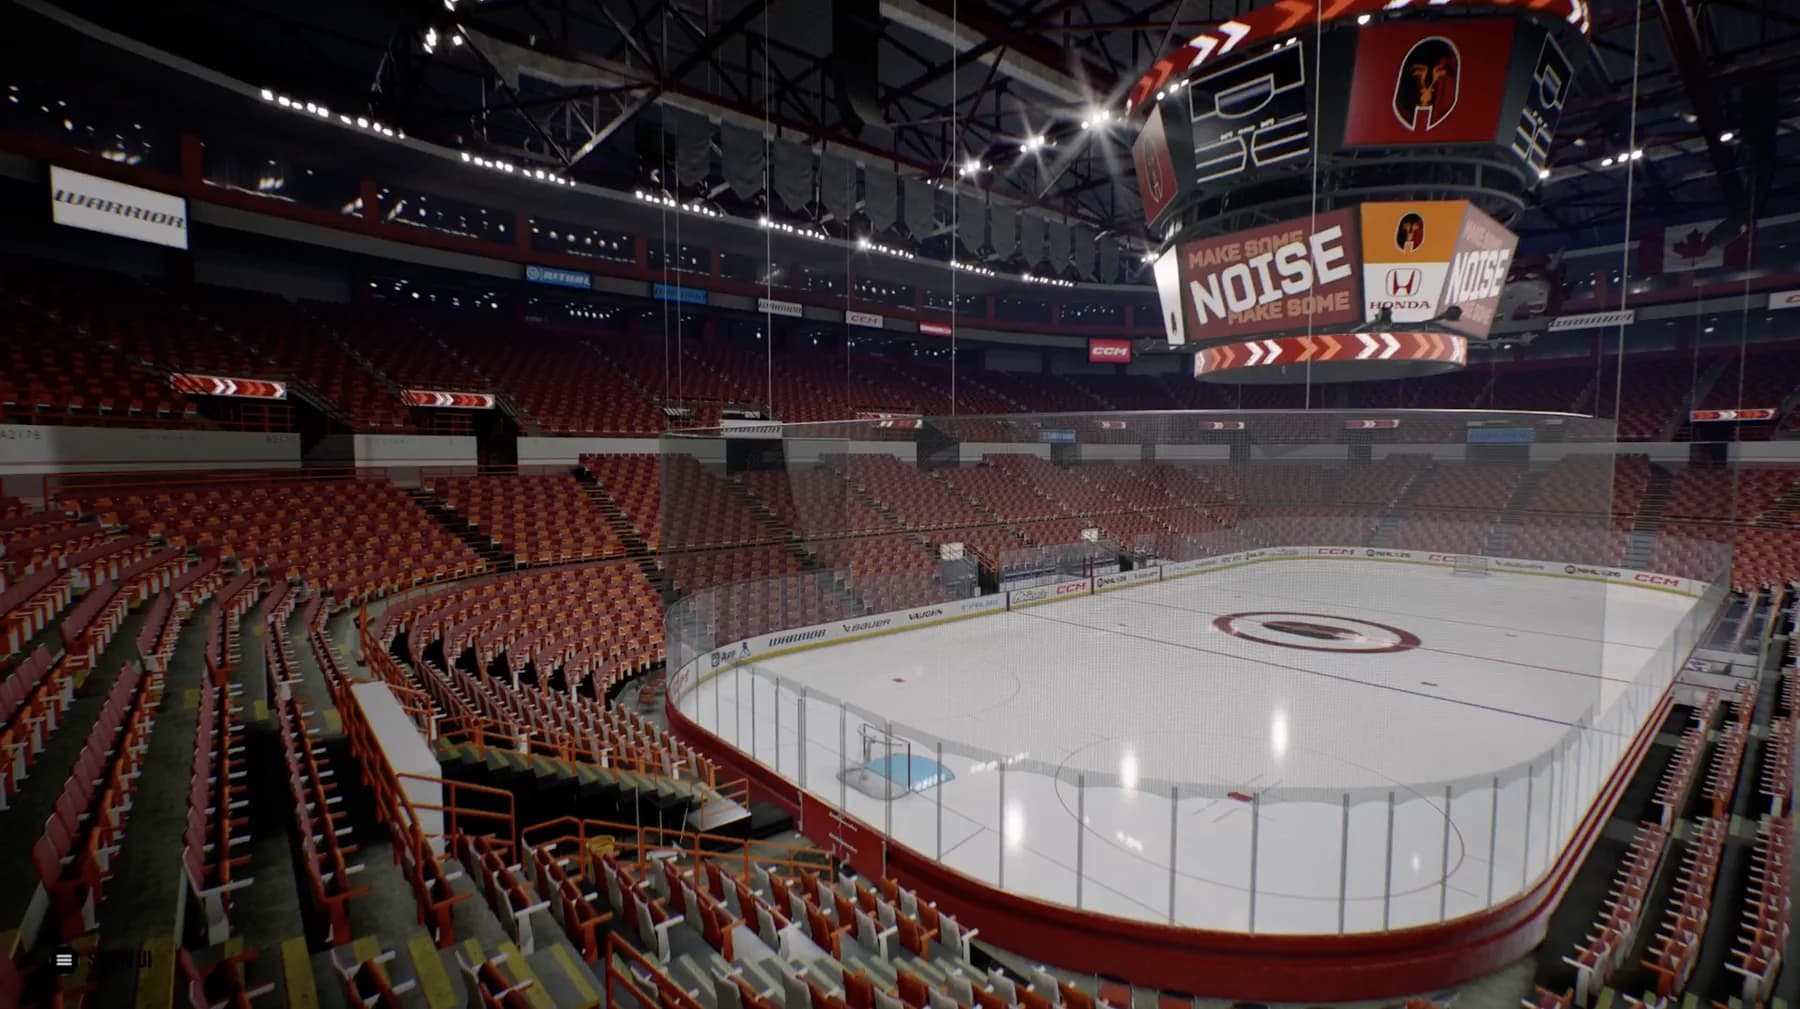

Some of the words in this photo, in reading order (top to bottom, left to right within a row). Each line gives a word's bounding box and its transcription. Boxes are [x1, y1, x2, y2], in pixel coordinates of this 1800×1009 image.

[55, 189, 186, 229] WARRIOR
[1189, 243, 1241, 269] MAKE
[1244, 230, 1304, 257] SOME
[1189, 225, 1352, 325] NOISE
[1445, 249, 1510, 305] NOISE
[1228, 302, 1284, 325] MAKE
[1287, 291, 1351, 317] SOME
[1369, 301, 1431, 310] HONDA
[851, 314, 878, 325] CCM
[1092, 346, 1128, 356] CCM
[1318, 548, 1355, 556] CCM
[1634, 573, 1680, 587] CCM
[1056, 582, 1087, 595] CCM
[908, 608, 943, 621] VAUGHN
